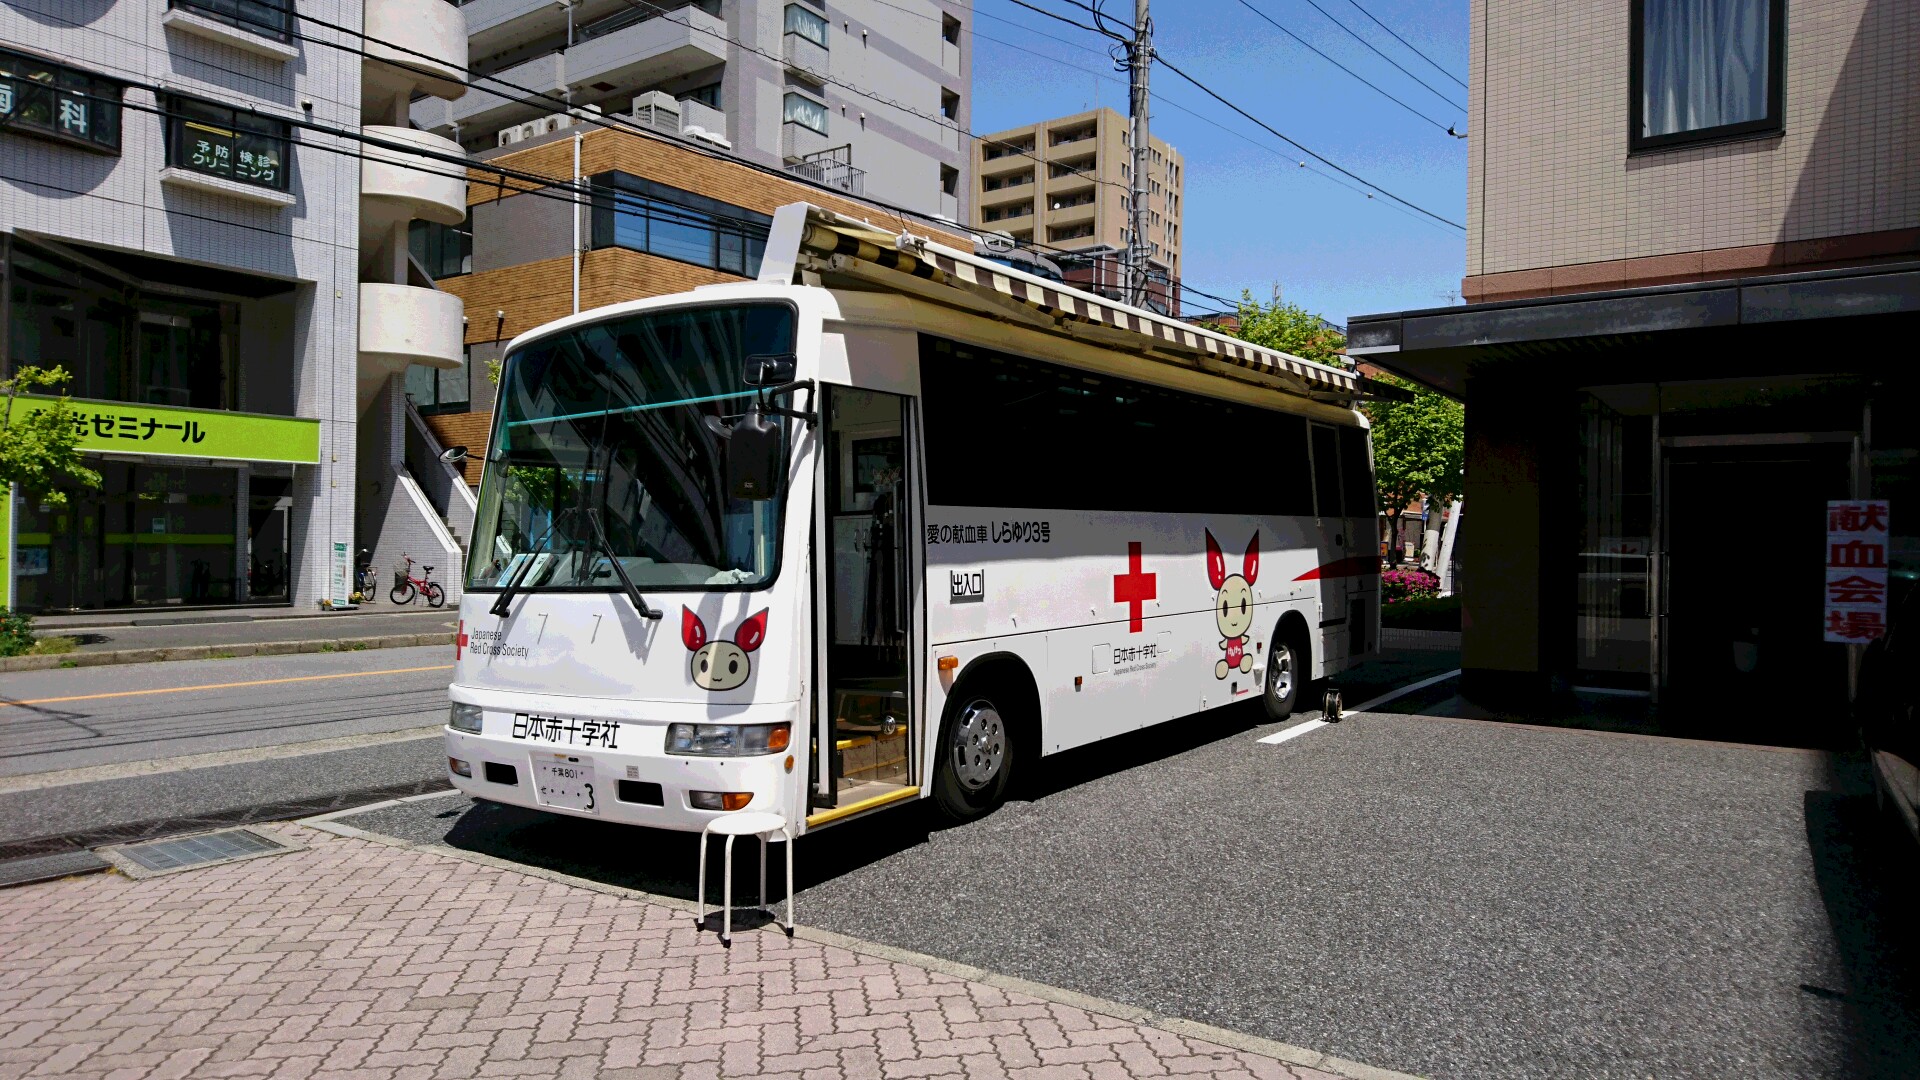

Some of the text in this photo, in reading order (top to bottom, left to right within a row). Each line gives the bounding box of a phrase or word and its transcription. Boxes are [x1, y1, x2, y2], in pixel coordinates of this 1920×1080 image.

[192, 152, 275, 181] クリーニング
[196, 139, 271, 168] 予防検診
[33, 408, 206, 443] 光ゼミナール
[927, 521, 1051, 545] 愛の献血車 しらゆり3号
[952, 573, 982, 596] 出入口
[1826, 504, 1889, 640] 献血会場
[470, 627, 502, 642] Japanese
[469, 642, 530, 660] Red Cross Society
[1113, 643, 1157, 665] 日本赤十字社
[512, 712, 621, 749] 日本赤十字社
[584, 783, 595, 810] 3
